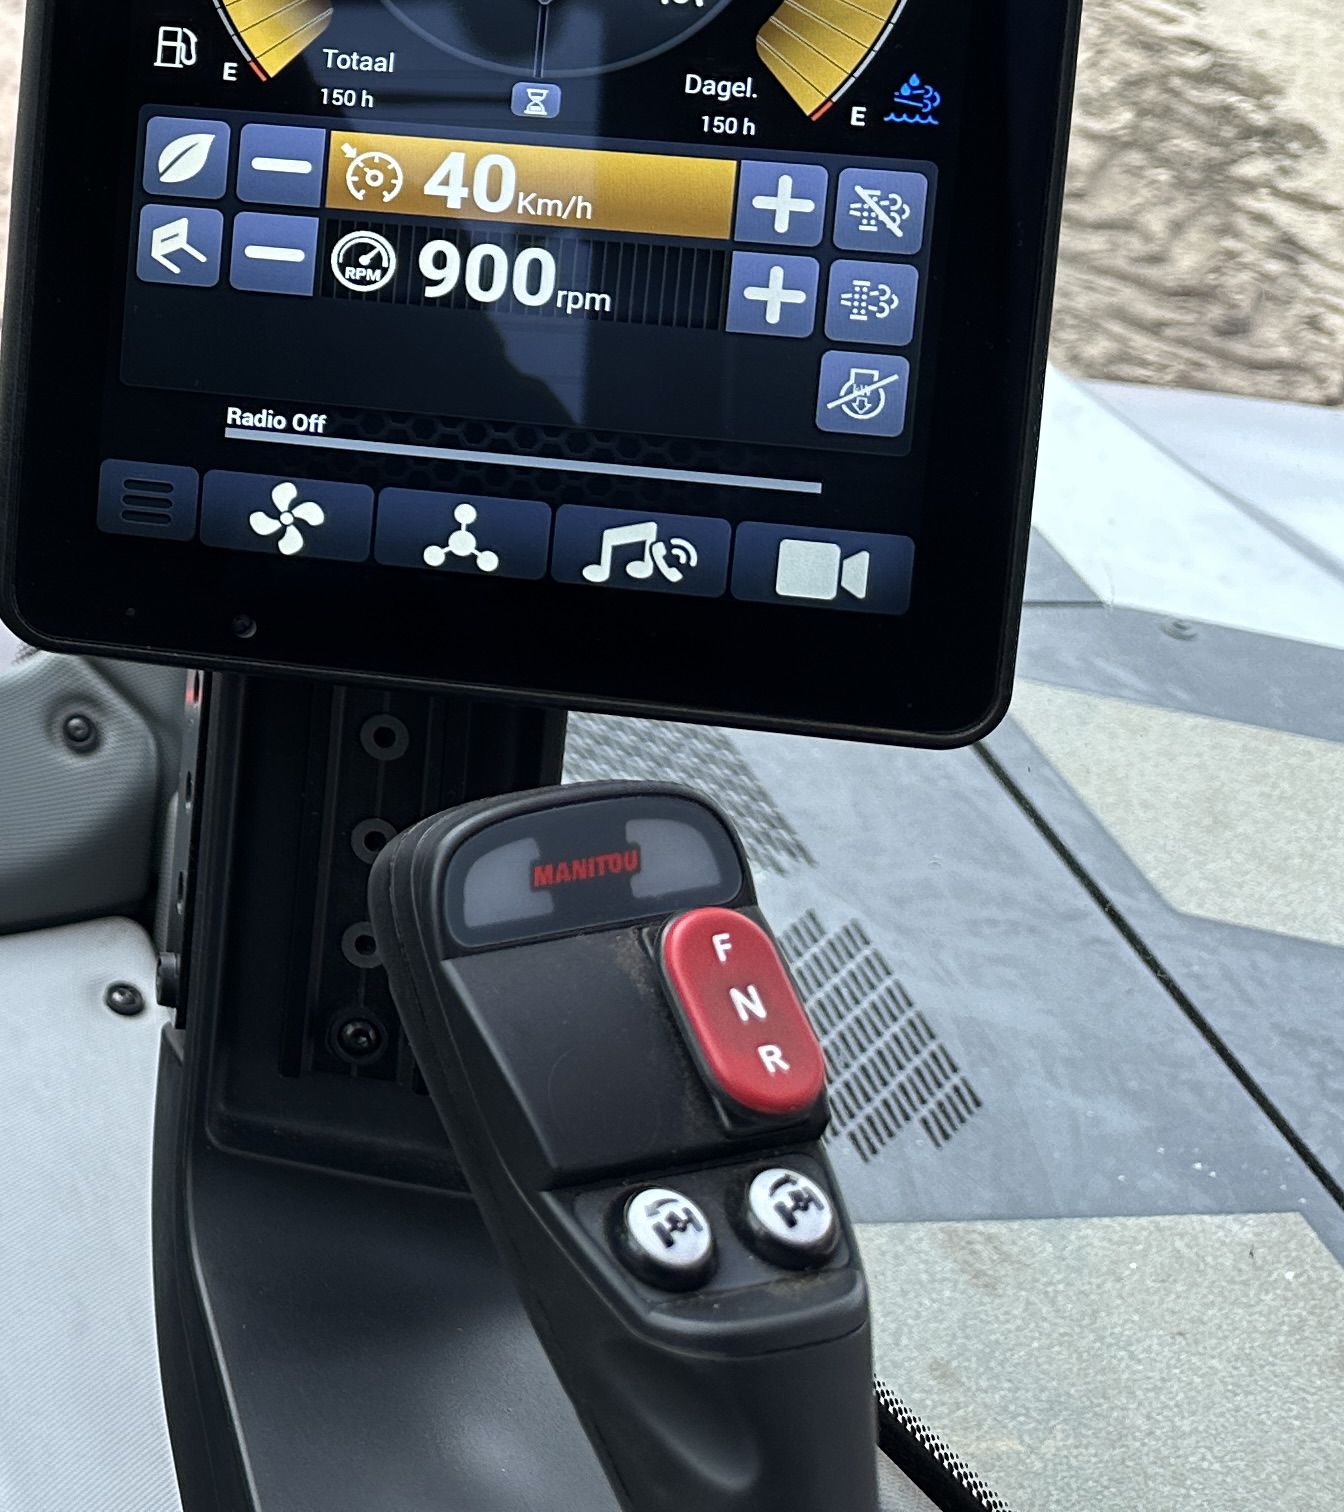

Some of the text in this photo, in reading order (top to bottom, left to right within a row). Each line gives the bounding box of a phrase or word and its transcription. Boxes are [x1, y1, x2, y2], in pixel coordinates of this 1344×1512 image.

[222, 61, 238, 82] E
[322, 48, 395, 73] Totaal
[320, 88, 374, 108] 150 h
[684, 73, 758, 102] Dagel.
[701, 115, 756, 136] 150 h
[850, 106, 867, 127] E
[423, 152, 594, 223] 40 Km/h
[344, 266, 382, 282] RPM
[418, 239, 612, 315] 900 rpm
[226, 406, 328, 435] Radio Off
[534, 850, 639, 888] MANITOU
[711, 932, 733, 962] F
[728, 984, 768, 1023] N
[757, 1043, 791, 1075] R
